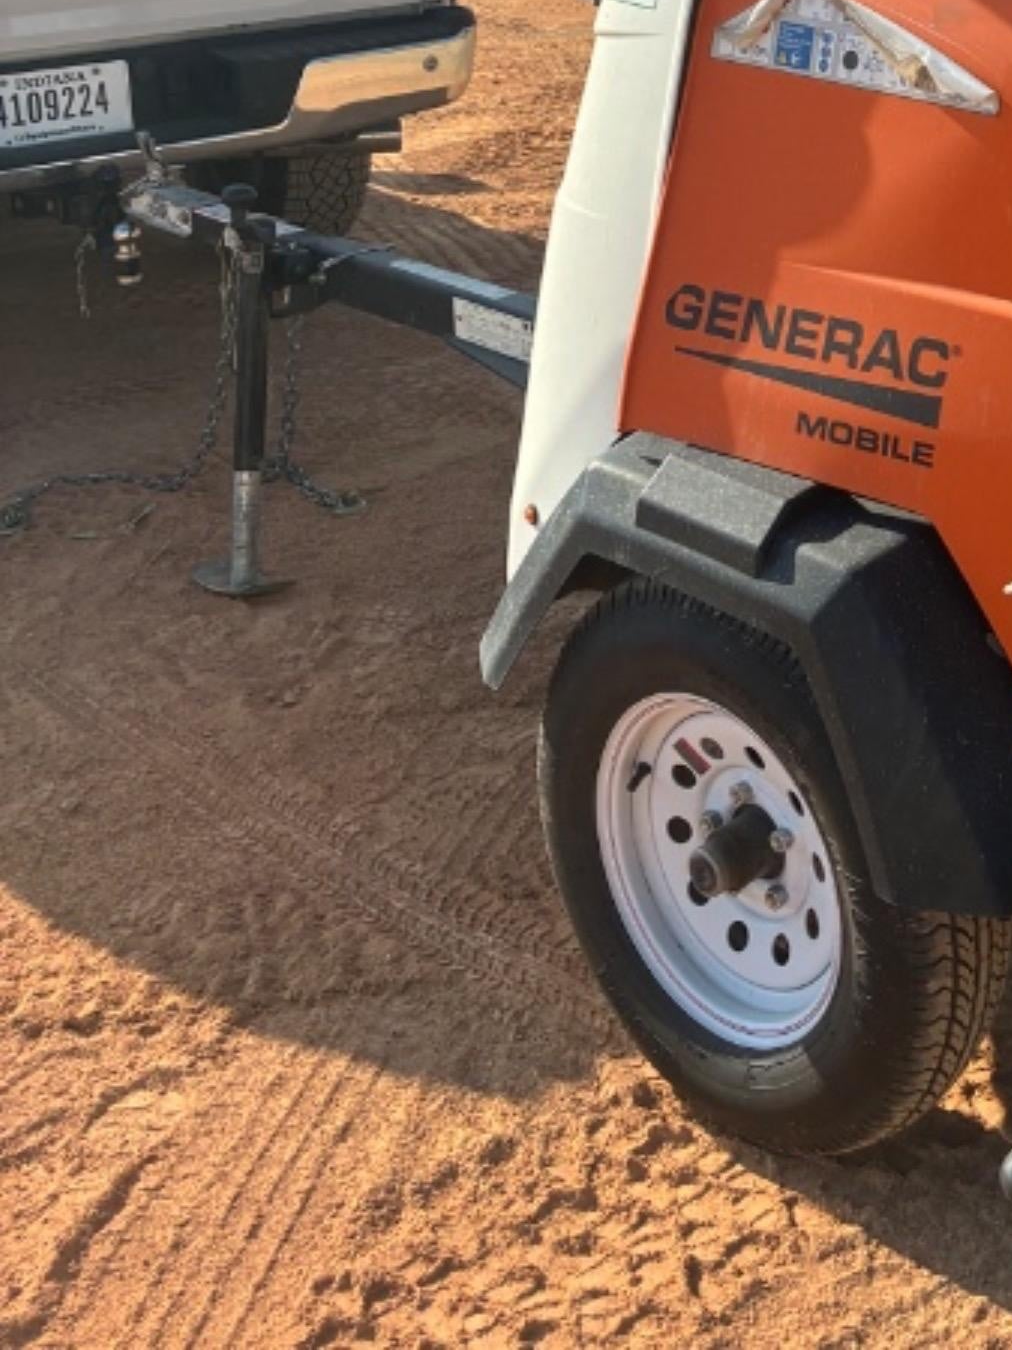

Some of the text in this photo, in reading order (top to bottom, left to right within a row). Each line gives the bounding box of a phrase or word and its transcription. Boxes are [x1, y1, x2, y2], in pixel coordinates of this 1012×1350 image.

[13, 70, 87, 91] INDIANA
[664, 283, 951, 389] GENERAC
[794, 411, 937, 469] MOBILE
